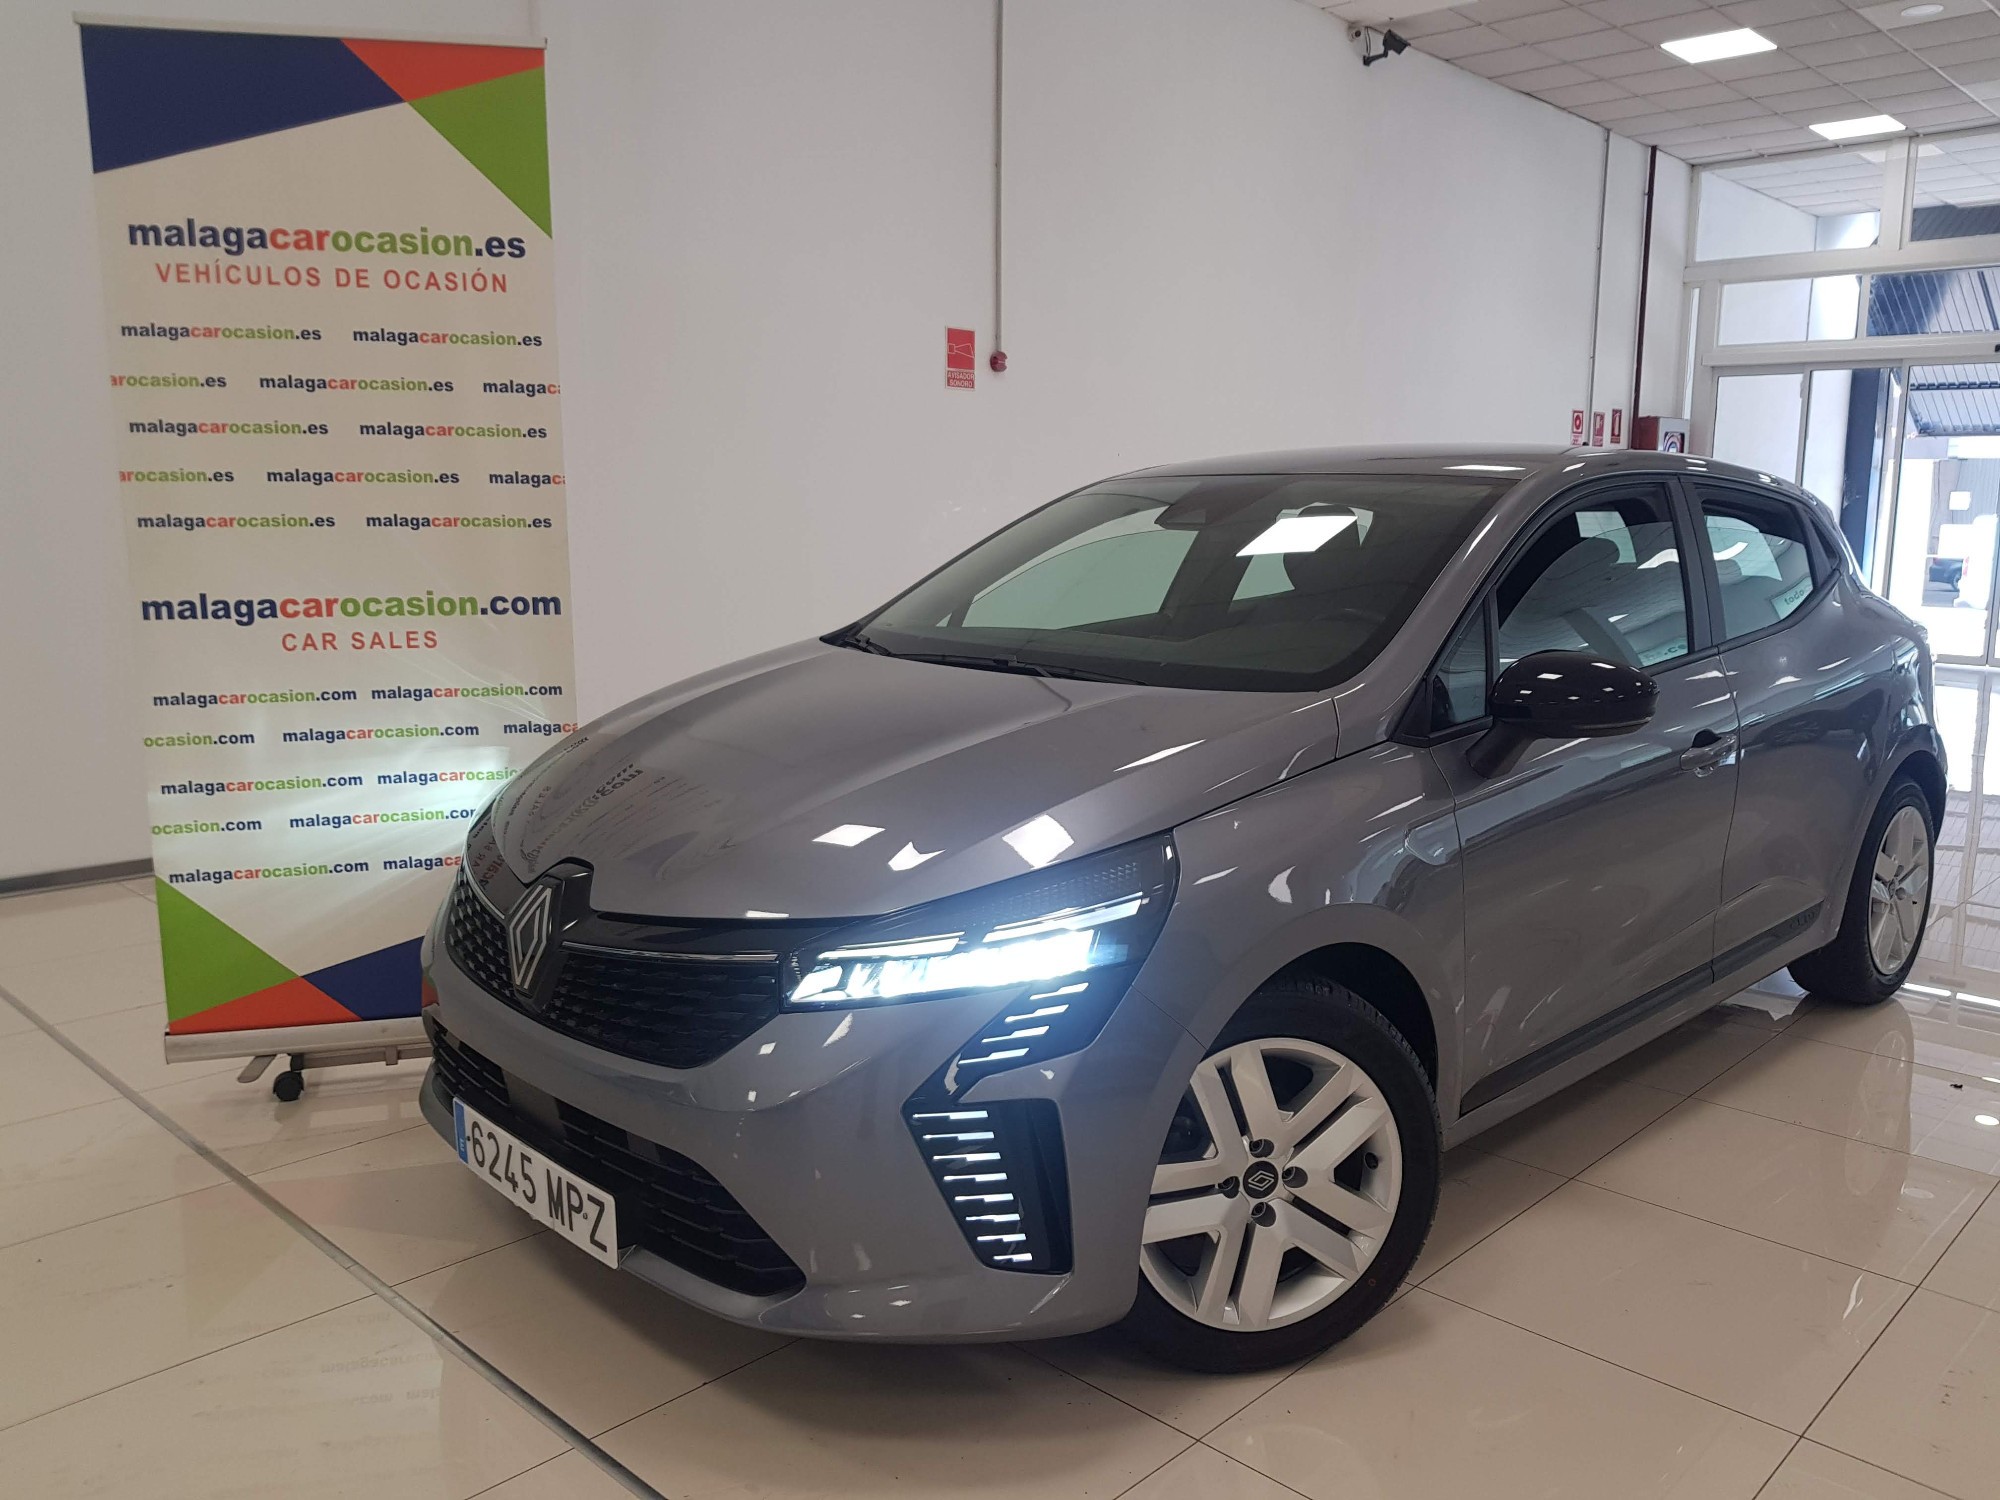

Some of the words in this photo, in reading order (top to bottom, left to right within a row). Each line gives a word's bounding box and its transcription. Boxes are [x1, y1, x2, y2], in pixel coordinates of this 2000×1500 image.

[127, 217, 529, 260] malagacarocasion.es
[154, 258, 321, 288] VEHÍCULOS
[334, 267, 371, 289] DE
[383, 266, 509, 294] OCASIÓN
[120, 322, 323, 342] malagacarocasion.es
[352, 327, 543, 347] malagacarocasion.es
[258, 373, 455, 394] malagacarocasion.es
[482, 379, 561, 398] malagac
[947, 371, 975, 380] AVISADOR
[949, 379, 973, 387] SONORO
[128, 418, 329, 438] malagacarocasion.es
[359, 421, 548, 440] malagacarocasion.es
[266, 467, 461, 487] malagacarocasion.es
[488, 470, 566, 489] malagac
[136, 513, 336, 532] malagacarocasion.es
[365, 511, 553, 531] malagacarocasion.es
[140, 589, 563, 628] malagacarocasion.com
[281, 631, 339, 653] CAR
[350, 629, 439, 651] SALES
[152, 688, 358, 709] malagacarocasion.com
[370, 682, 563, 702] malagacarocasion.com
[143, 732, 256, 748] ocasion.com
[282, 723, 480, 745] malagacarocasion.com
[160, 775, 364, 797] malagacarocasion.com
[150, 819, 263, 837] ocasion.com
[168, 861, 370, 885] malagacarocasion.com
[471, 1120, 537, 1205] 6245
[546, 1168, 608, 1253] MPZ
